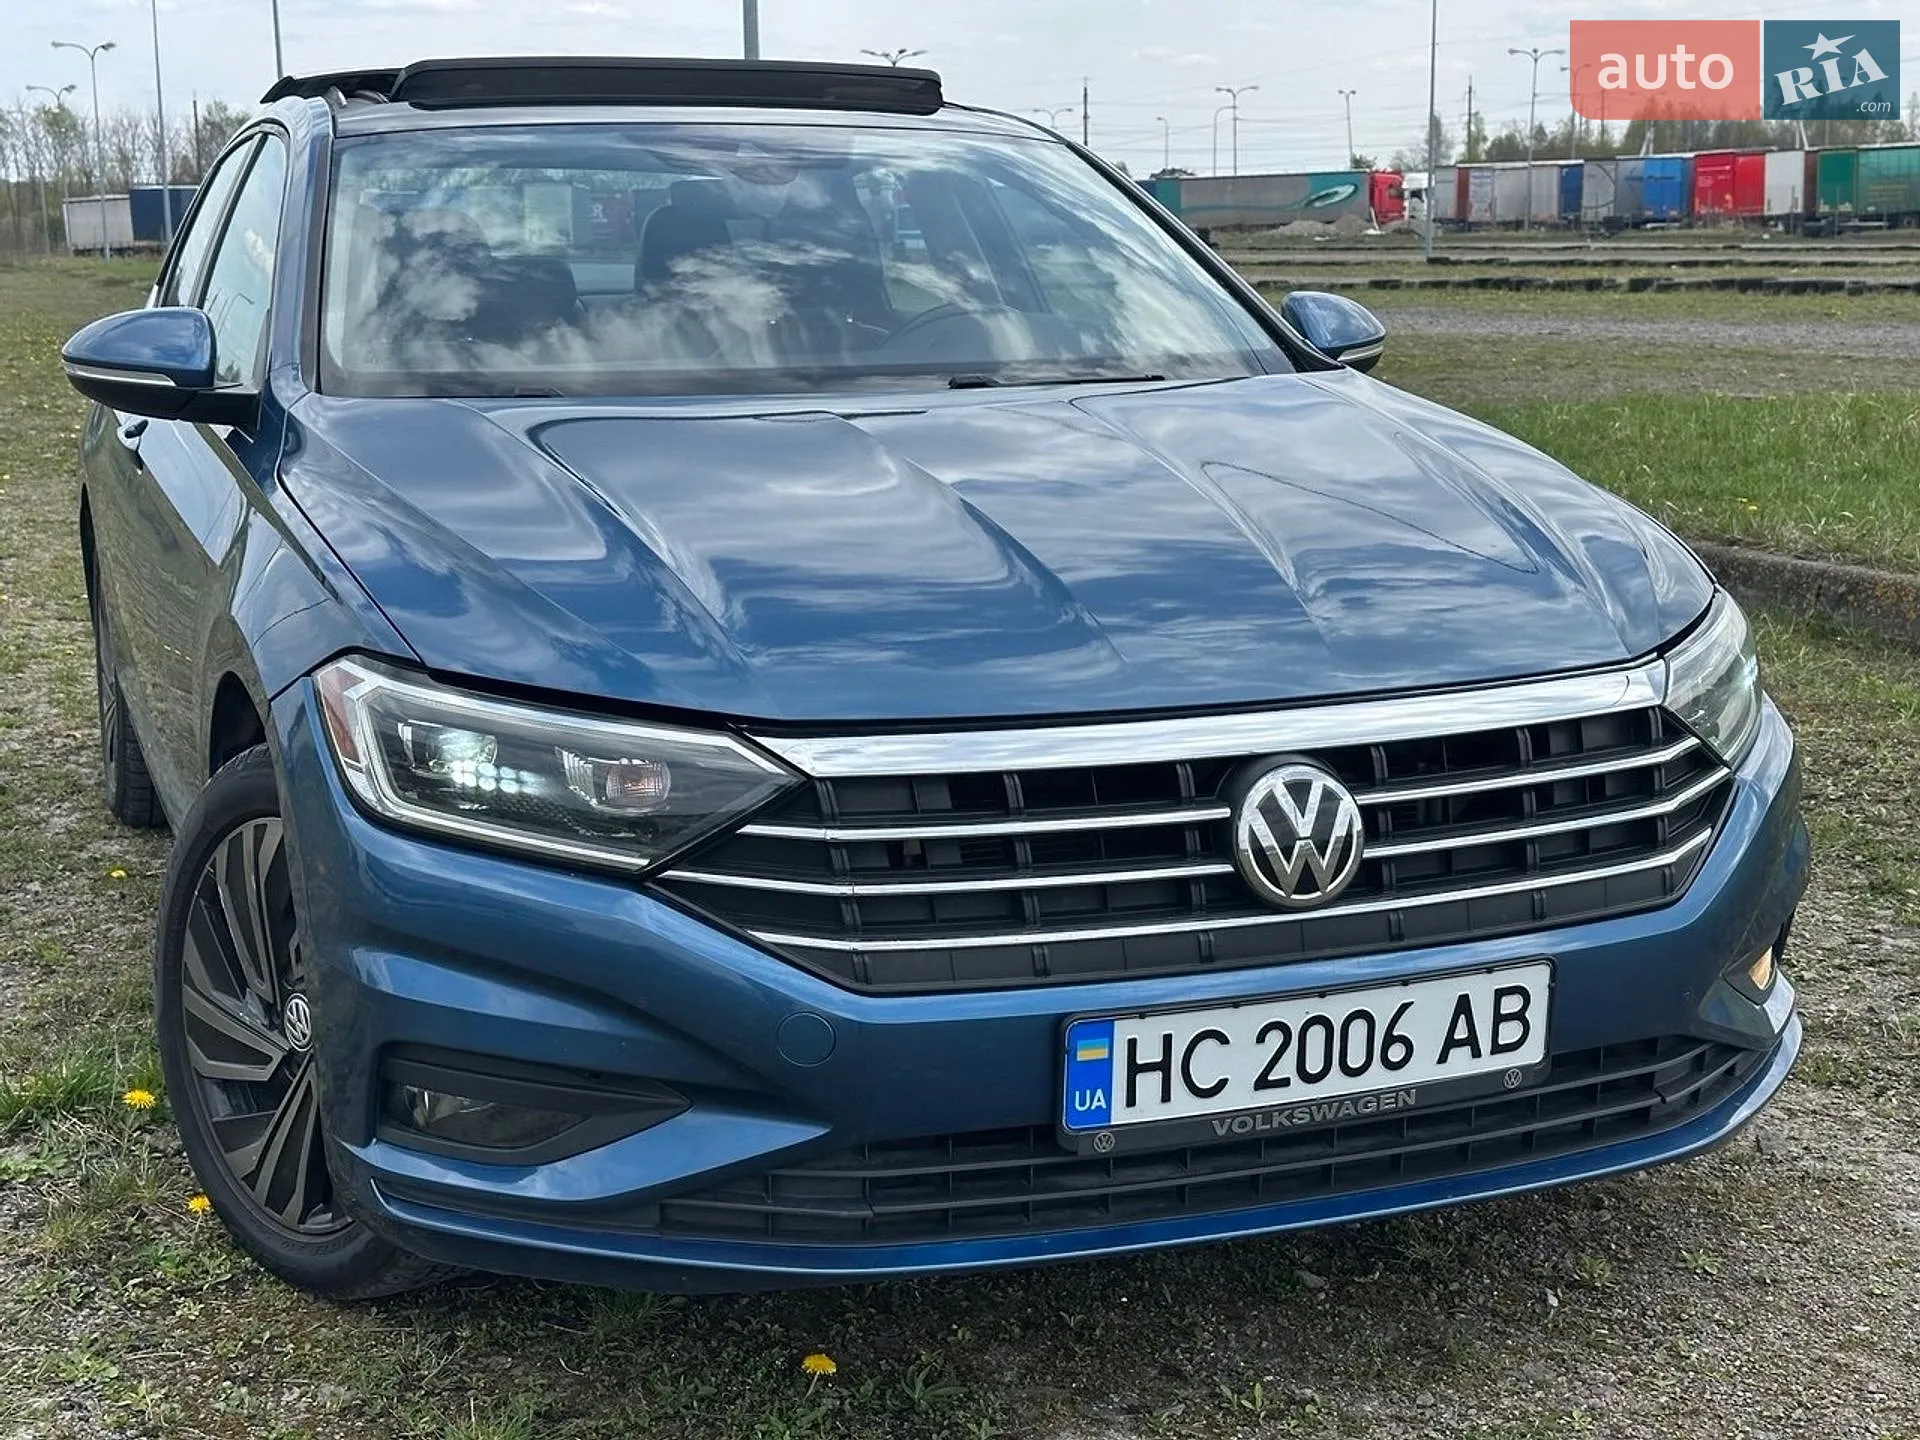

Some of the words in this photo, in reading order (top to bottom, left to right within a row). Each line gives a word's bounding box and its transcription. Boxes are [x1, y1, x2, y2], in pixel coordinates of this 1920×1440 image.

[1125, 1027, 1230, 1108] HC
[1253, 1000, 1415, 1091] 2006
[1435, 984, 1533, 1065] AB
[1074, 1089, 1107, 1112] UA
[1211, 1088, 1417, 1137] VOLKSWAGEN
